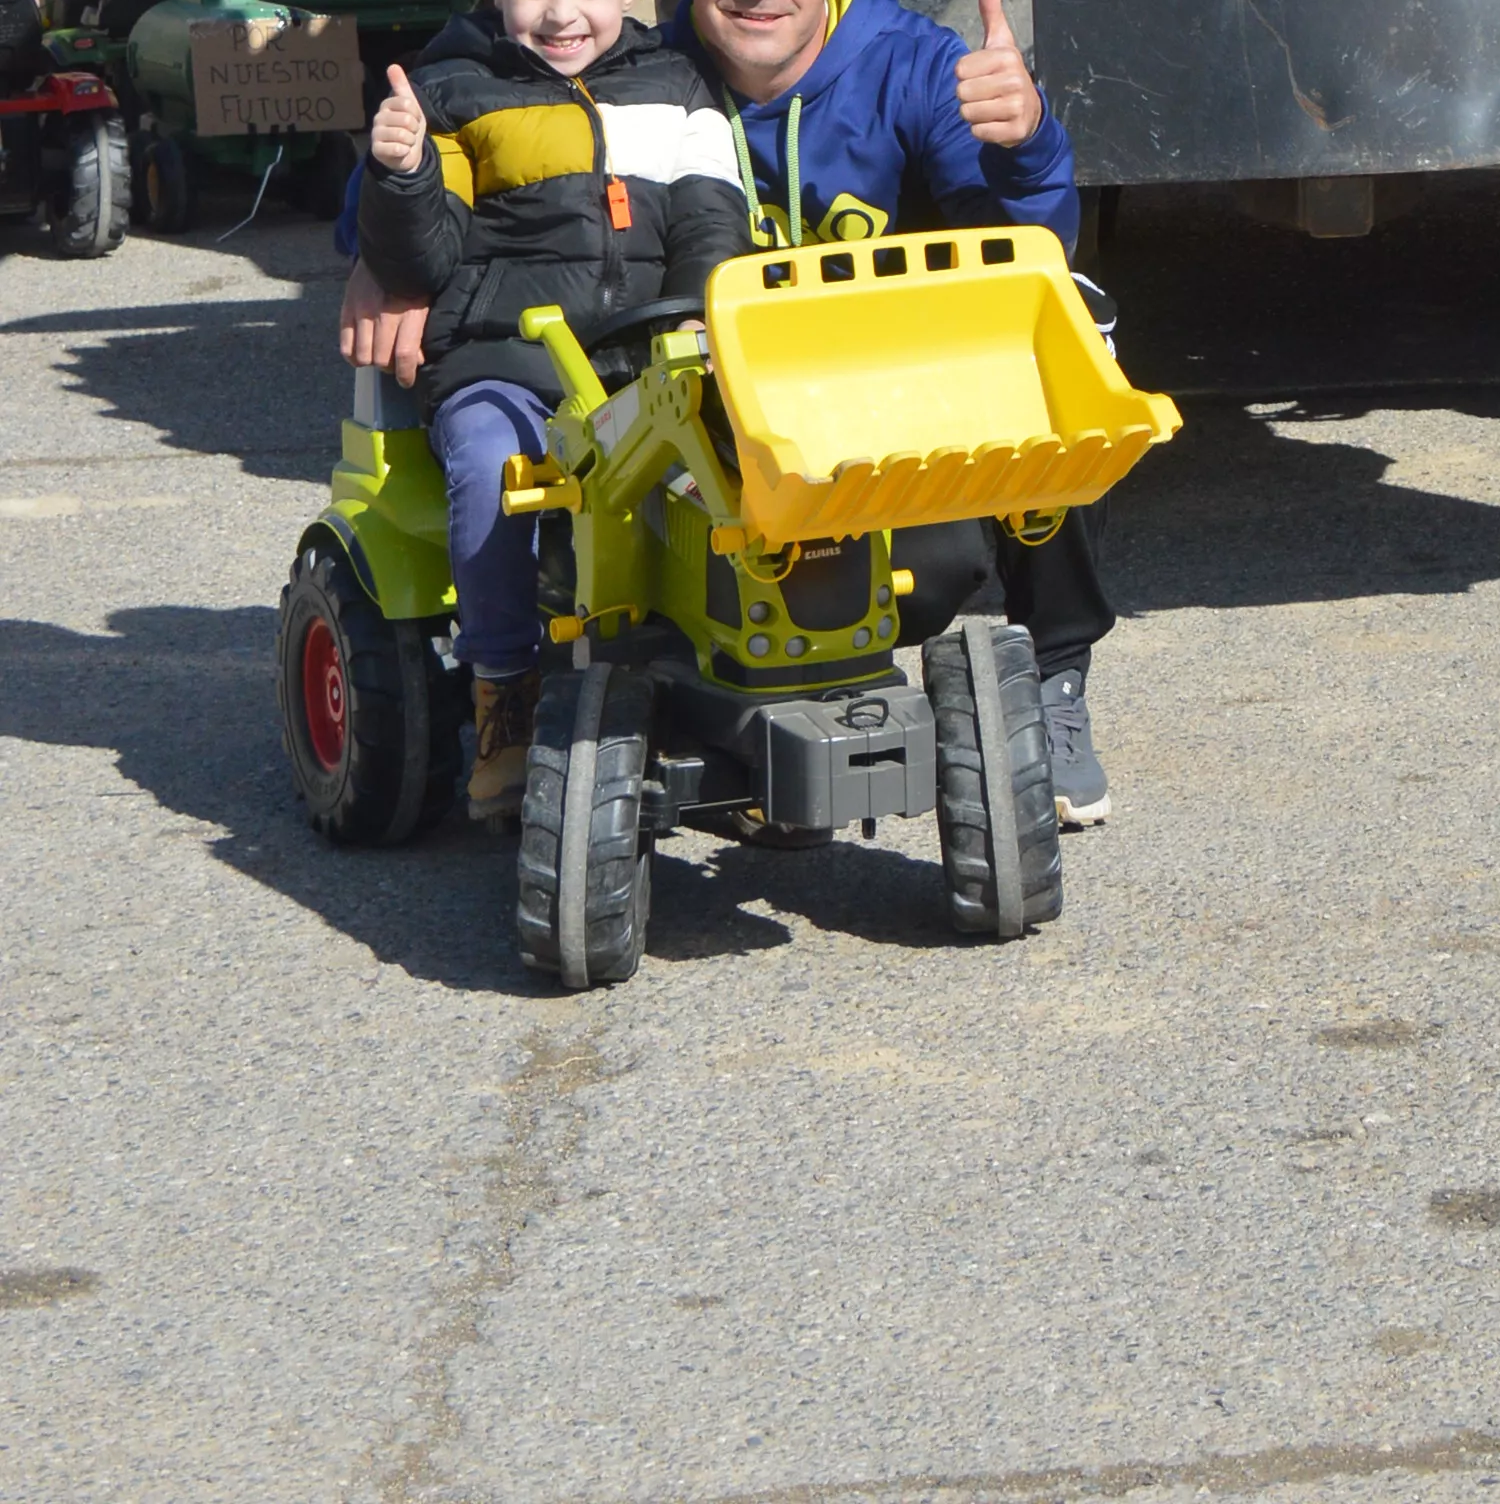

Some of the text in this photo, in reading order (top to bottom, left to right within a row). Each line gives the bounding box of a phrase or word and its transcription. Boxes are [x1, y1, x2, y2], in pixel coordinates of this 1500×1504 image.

[231, 24, 285, 52] POR
[210, 60, 339, 85] NUESTRO
[220, 94, 335, 124] FUTURO
